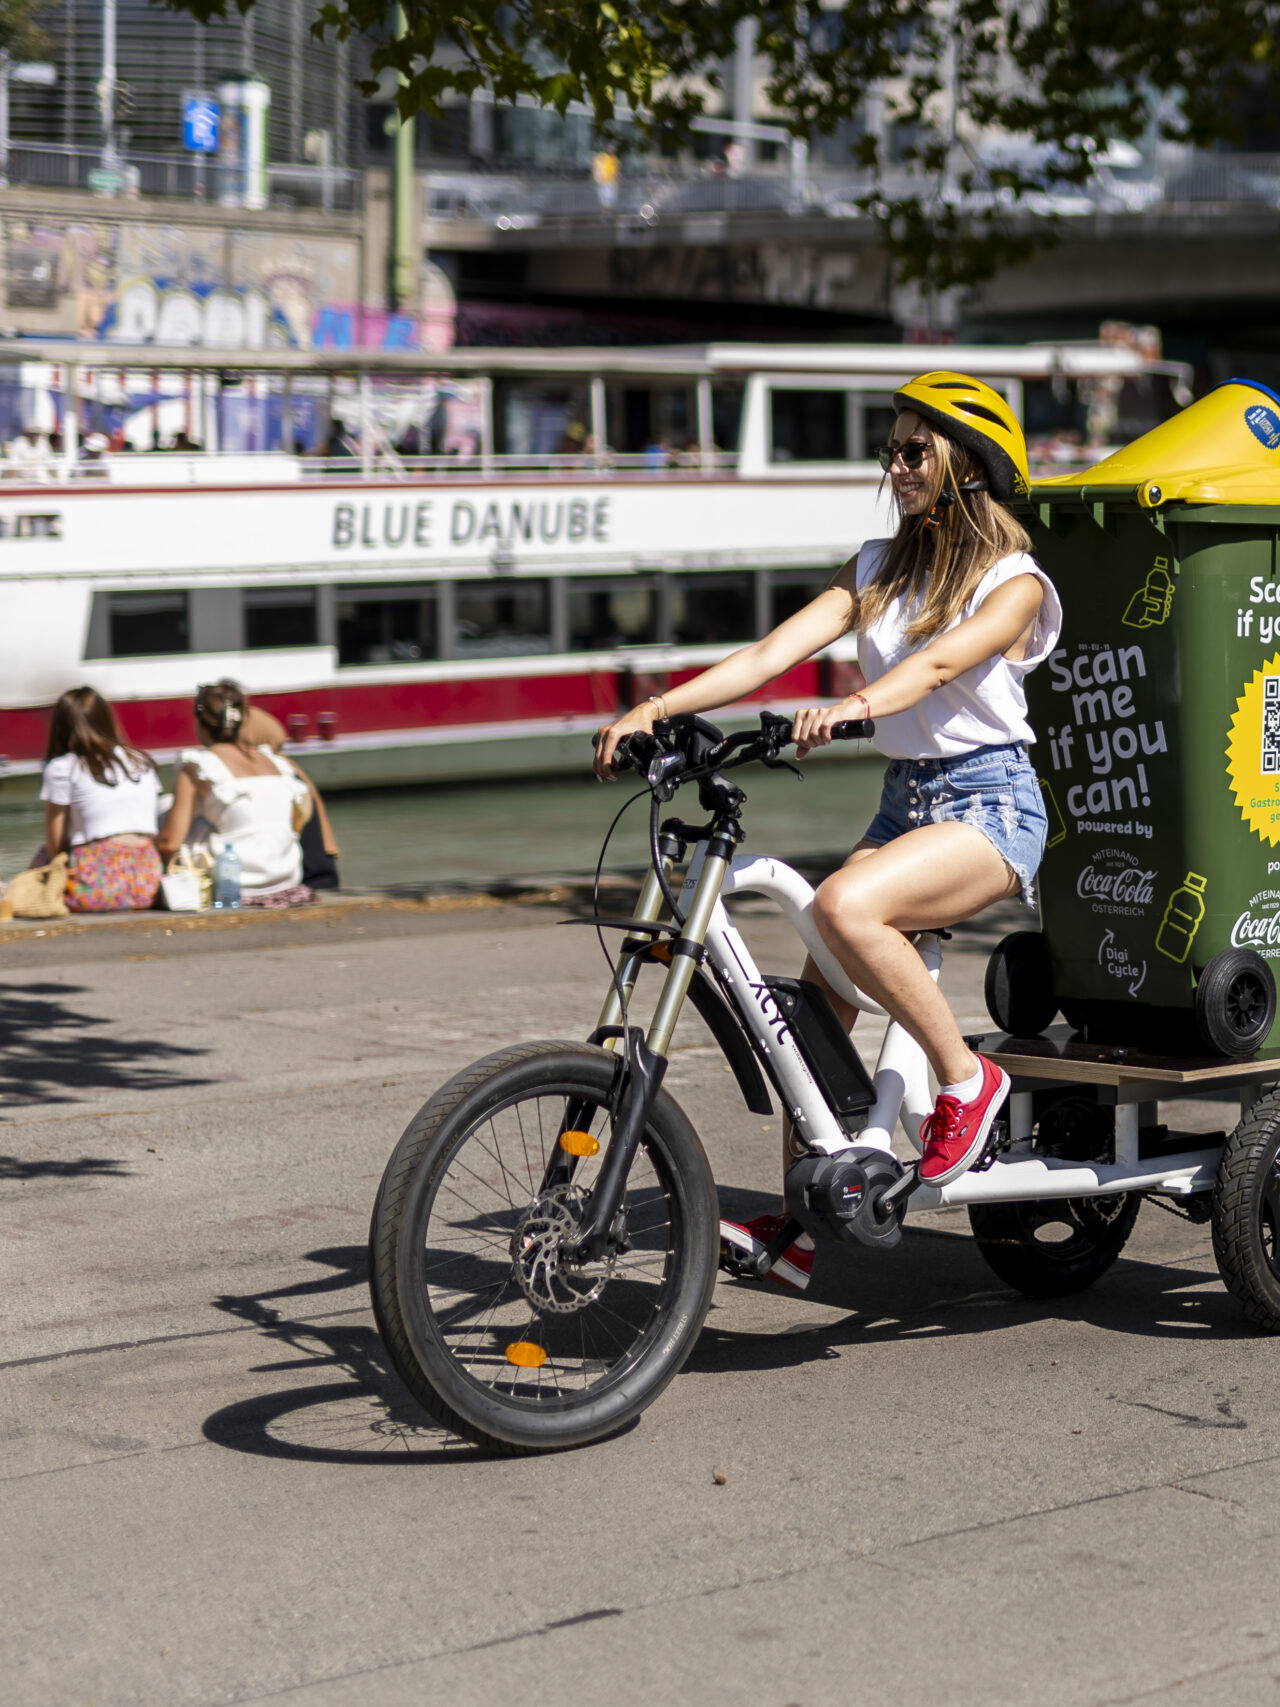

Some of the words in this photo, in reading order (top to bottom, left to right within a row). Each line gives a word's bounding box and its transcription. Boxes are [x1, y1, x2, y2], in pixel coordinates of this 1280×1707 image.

[332, 502, 432, 549] BLUE
[449, 497, 612, 545] DANUBE
[1236, 608, 1254, 636] if
[1048, 645, 1147, 692] Scan
[1071, 685, 1136, 726] me
[1048, 725, 1074, 771] if
[1085, 721, 1168, 775] you
[1066, 763, 1152, 817] can!
[1076, 820, 1133, 836] powered
[1135, 821, 1153, 839] by
[1091, 848, 1139, 867] MITEINAND
[1076, 865, 1158, 904] Coca-Cola
[1091, 903, 1145, 917] ÖSTERREICH
[1106, 947, 1129, 963] Digi
[1107, 961, 1139, 977] Cycle
